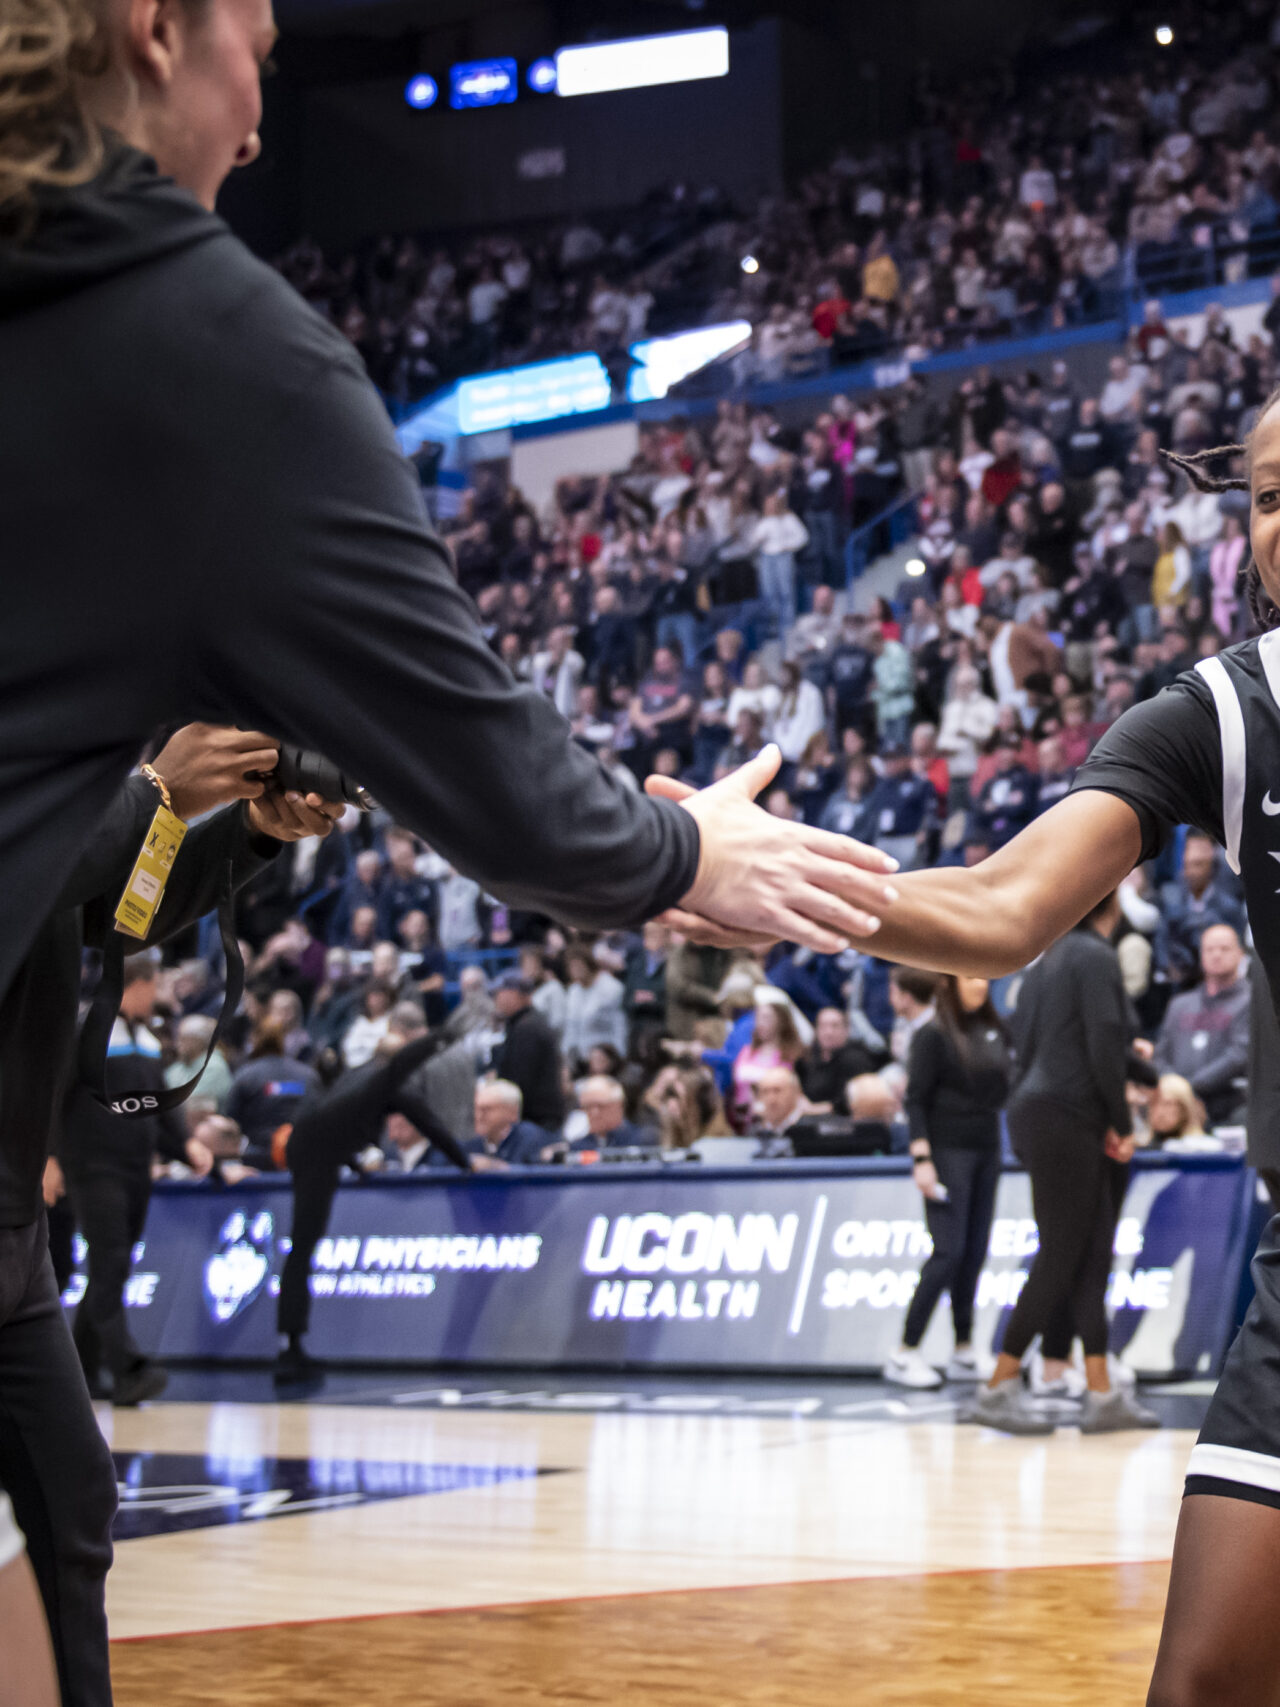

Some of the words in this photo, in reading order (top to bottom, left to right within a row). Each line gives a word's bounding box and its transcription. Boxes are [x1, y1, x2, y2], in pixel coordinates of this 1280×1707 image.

[363, 1235, 543, 1270] PHYSICIANS
[584, 1213, 798, 1274] UCONN
[590, 1279, 760, 1321] HEALTH
